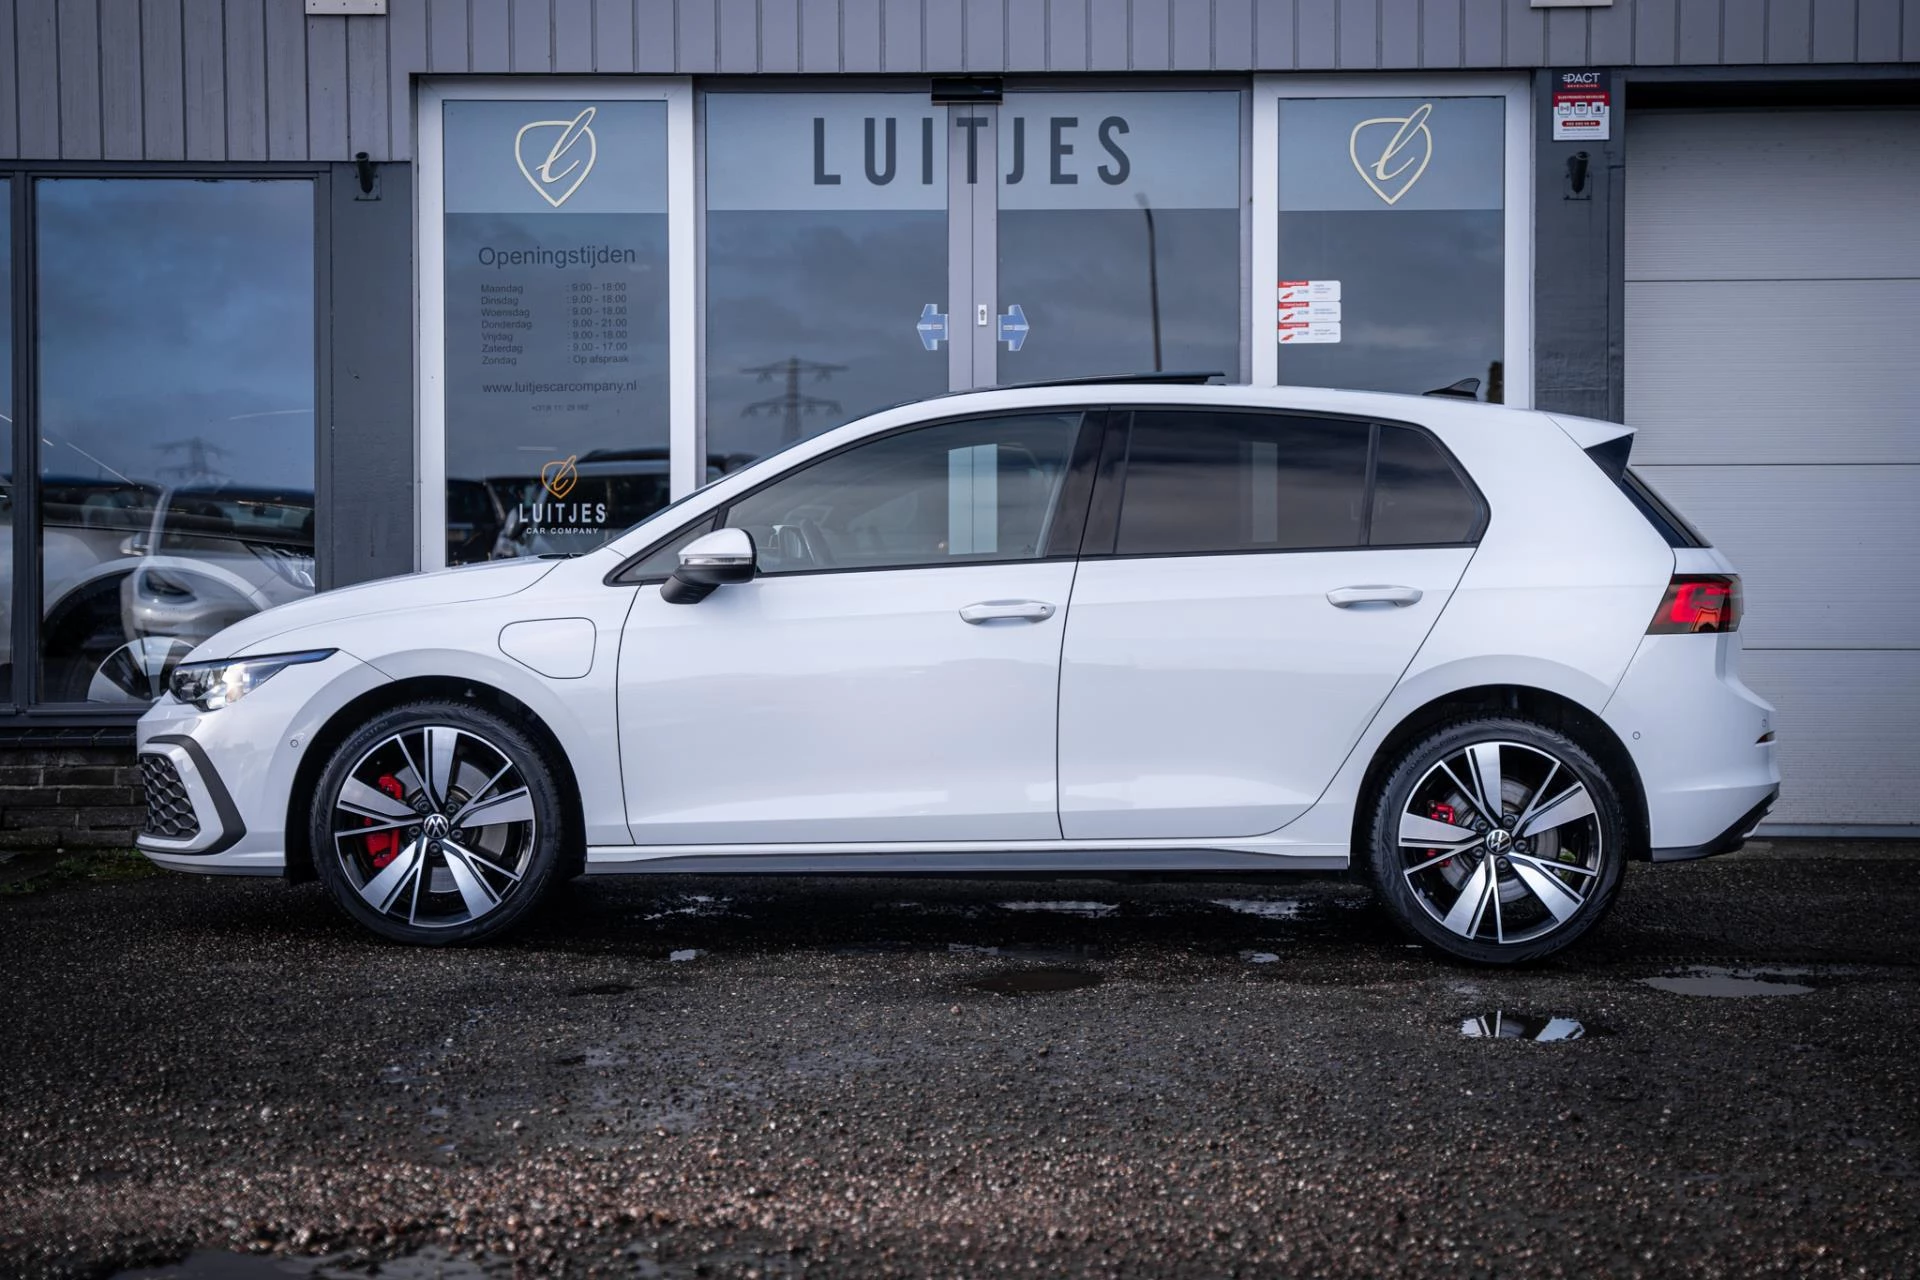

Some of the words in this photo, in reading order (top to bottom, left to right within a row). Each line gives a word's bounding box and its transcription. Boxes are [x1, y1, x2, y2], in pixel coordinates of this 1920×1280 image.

[814, 116, 1130, 186] LUITJES
[478, 246, 636, 269] Openingstijden
[481, 284, 524, 295] Maandag
[481, 296, 519, 306] Dinsdag
[481, 308, 530, 319] Woensdag
[481, 320, 533, 331] Donderdag
[481, 331, 513, 343] Vrijdag
[481, 343, 524, 355] Zaterdag
[482, 355, 517, 366] Zondag
[573, 355, 587, 365] Op
[590, 355, 629, 365] afspraak
[482, 380, 637, 395] www.luitjescarcompany.nl
[519, 503, 606, 523] LUITJES
[526, 527, 546, 535] CAR
[550, 527, 599, 535] COMPANY
